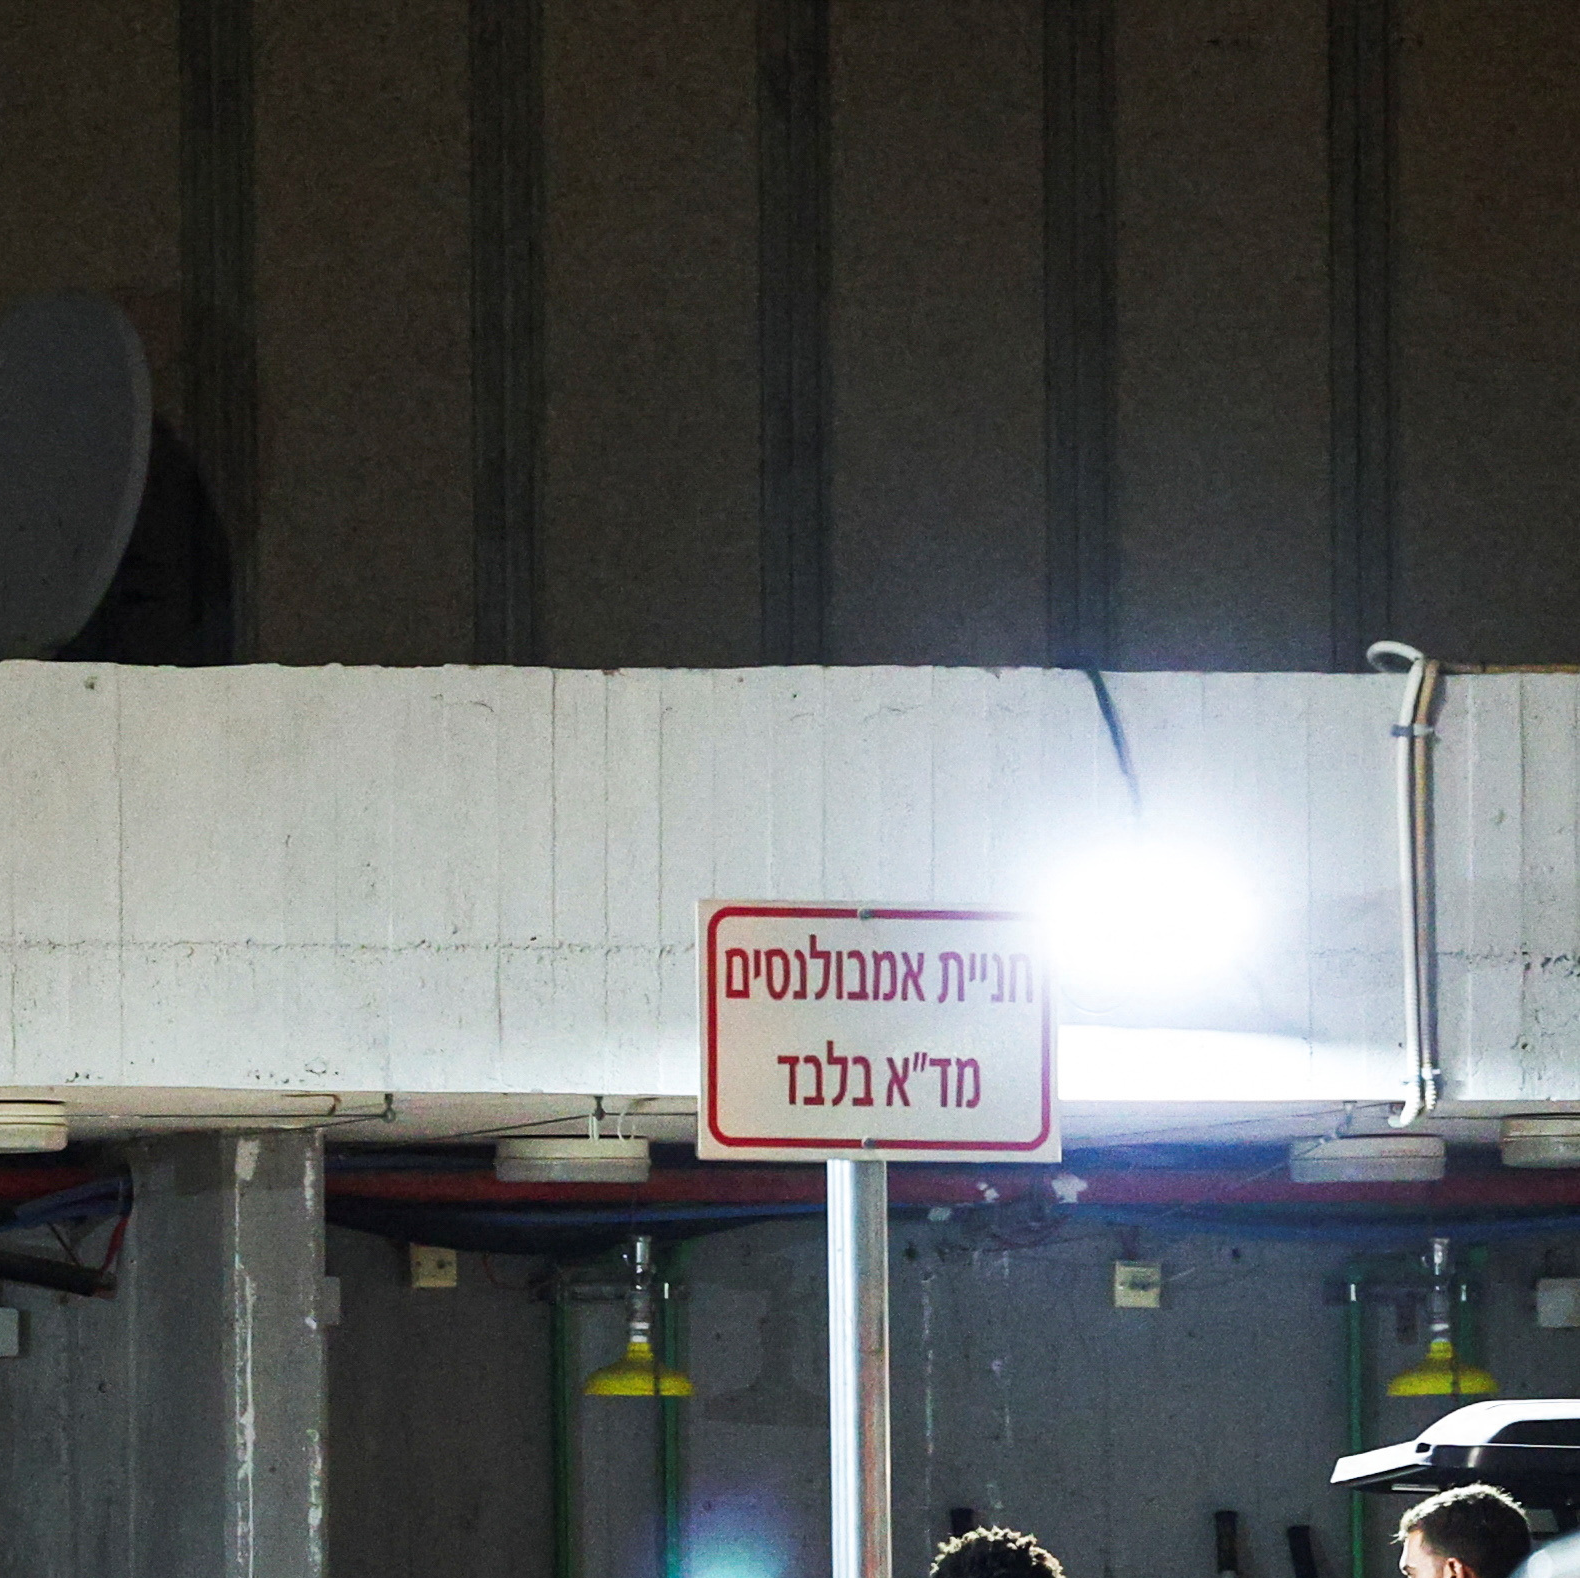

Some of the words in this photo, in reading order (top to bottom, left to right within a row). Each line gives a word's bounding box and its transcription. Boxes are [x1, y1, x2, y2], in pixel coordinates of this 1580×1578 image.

[724, 934, 926, 1003] אמבולנסים
[934, 950, 1034, 1005] חניית
[777, 1040, 875, 1107] בלבד
